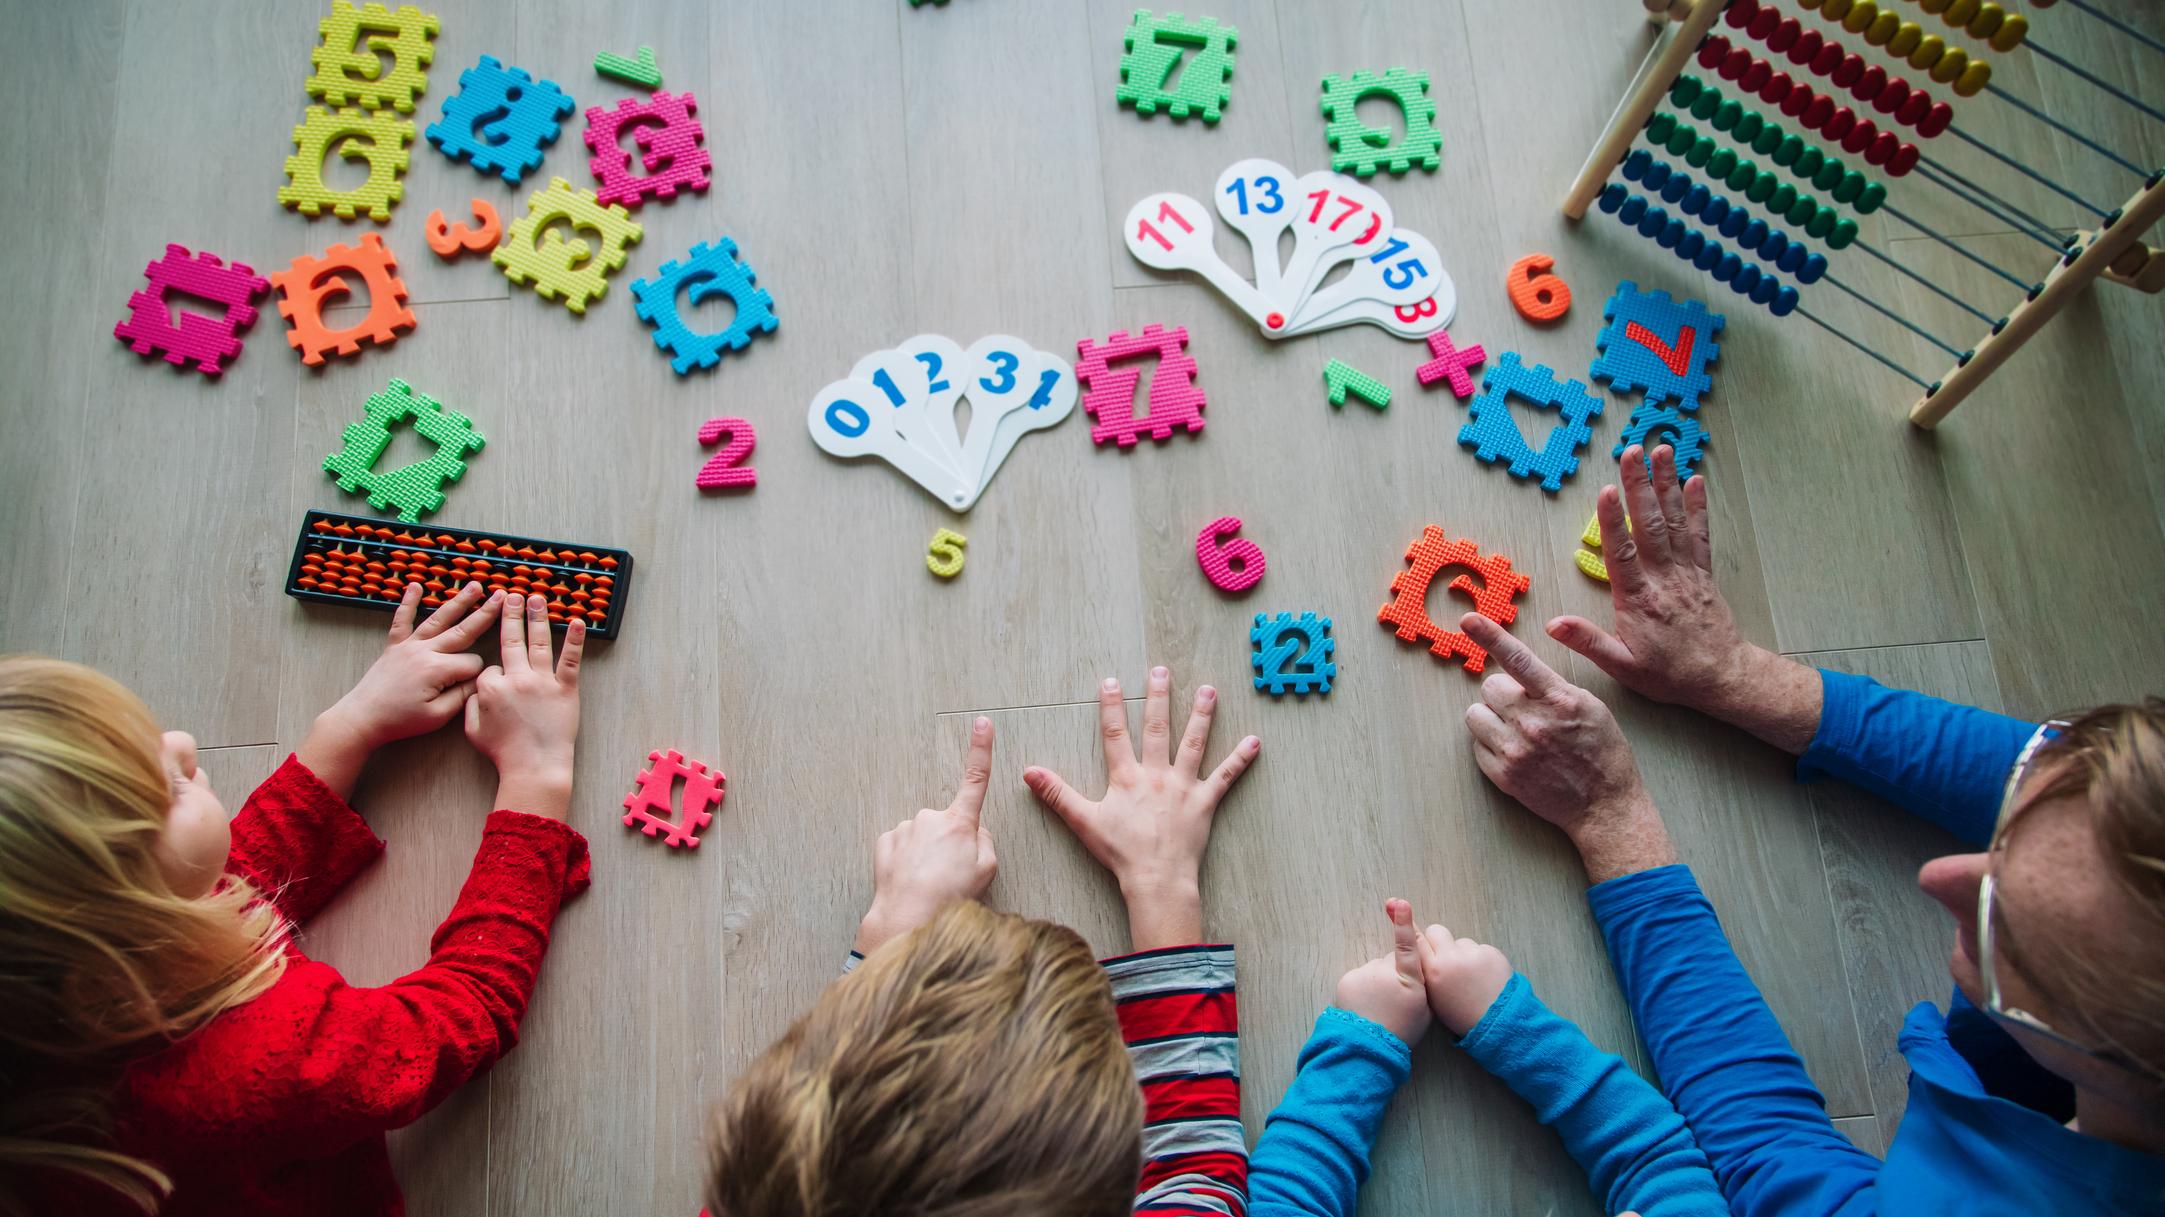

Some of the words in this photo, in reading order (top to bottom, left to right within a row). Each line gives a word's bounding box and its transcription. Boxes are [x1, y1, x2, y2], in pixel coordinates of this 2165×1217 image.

[340, 23, 401, 82] 5
[1153, 30, 1208, 91] 7
[318, 129, 376, 193] 6
[1226, 175, 1284, 216] 13
[1307, 188, 1363, 233] 17
[425, 198, 502, 259] 3
[532, 211, 604, 271] 3
[1137, 201, 1195, 252] 11
[1370, 236, 1429, 290] 15
[1506, 252, 1573, 324] 6
[979, 350, 1019, 395] 3
[1625, 319, 1696, 377] 7
[872, 368, 907, 409] 1
[1104, 349, 1163, 421] 7
[825, 399, 870, 438] 0
[696, 416, 757, 490] 2
[926, 528, 968, 578] 5
[1196, 515, 1266, 594] 6
[1274, 626, 1315, 674] 2
